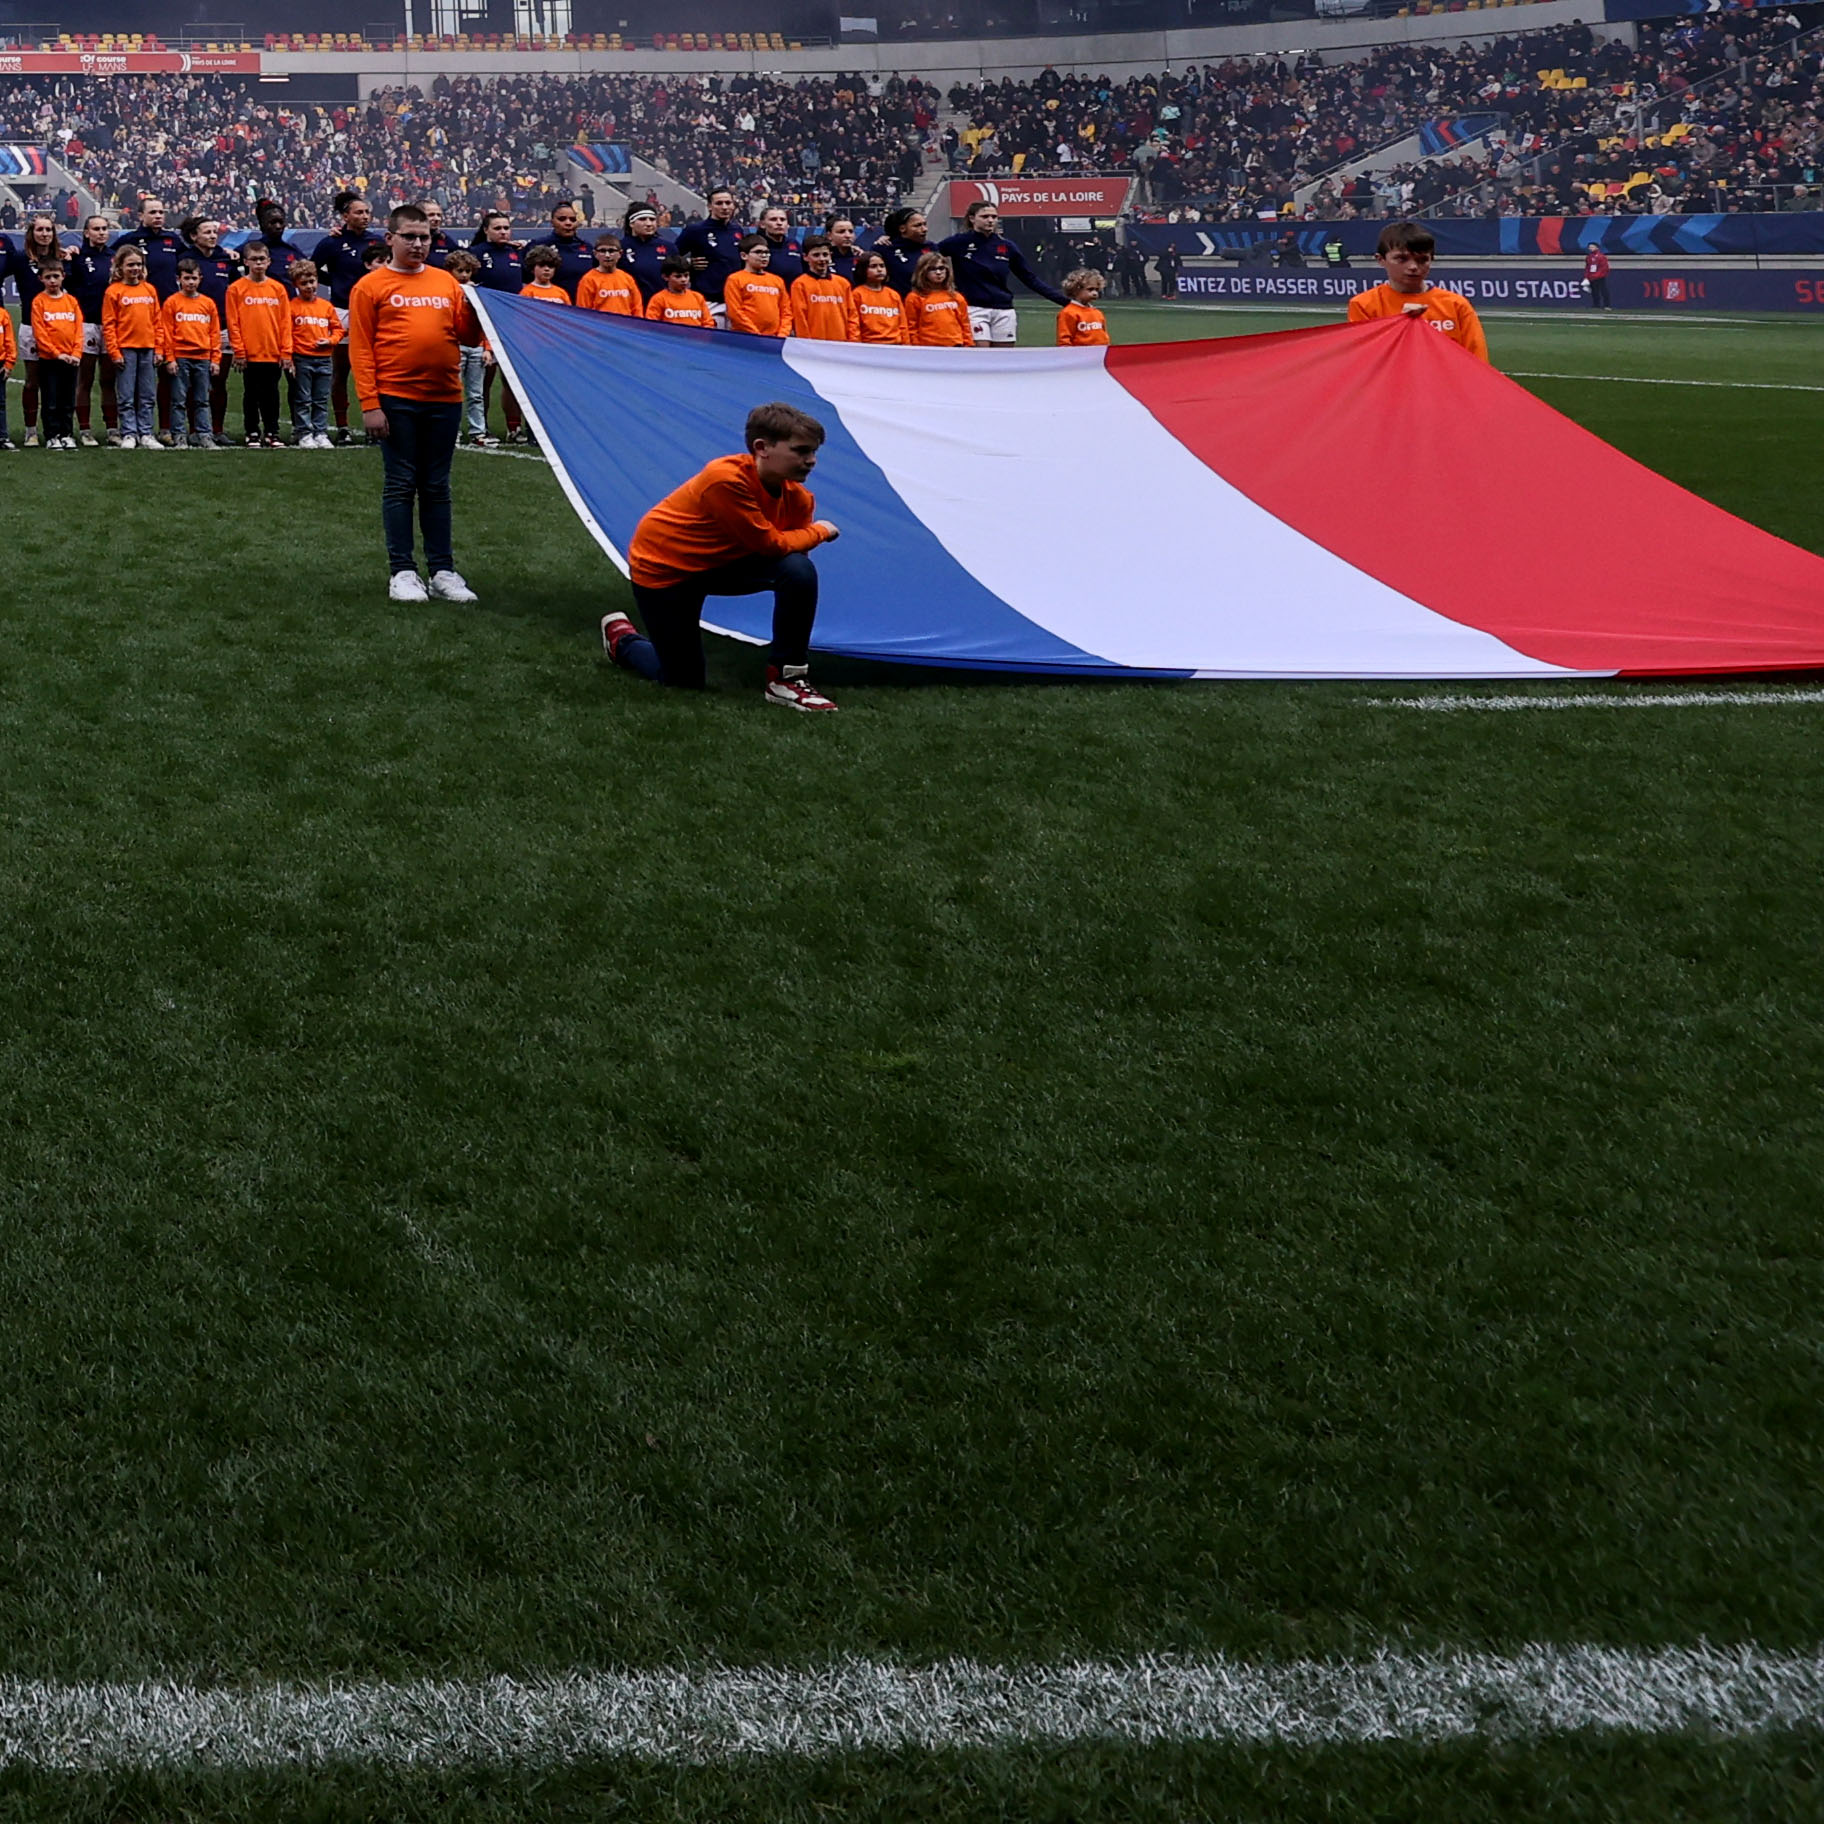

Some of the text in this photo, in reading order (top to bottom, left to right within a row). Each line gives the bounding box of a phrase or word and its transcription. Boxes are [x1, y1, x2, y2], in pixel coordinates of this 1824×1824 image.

[1001, 191, 1104, 203] PAYS DE LA LOIRE
[1176, 277, 1227, 293] ENTEZ
[1230, 278, 1250, 294] DE
[1256, 278, 1318, 295] PASSER
[1323, 279, 1357, 296] SUR
[1481, 280, 1508, 297] DU
[1514, 281, 1582, 298] STADE
[245, 297, 278, 305] Orange
[390, 294, 449, 309] Orange
[861, 304, 898, 317] Orange
